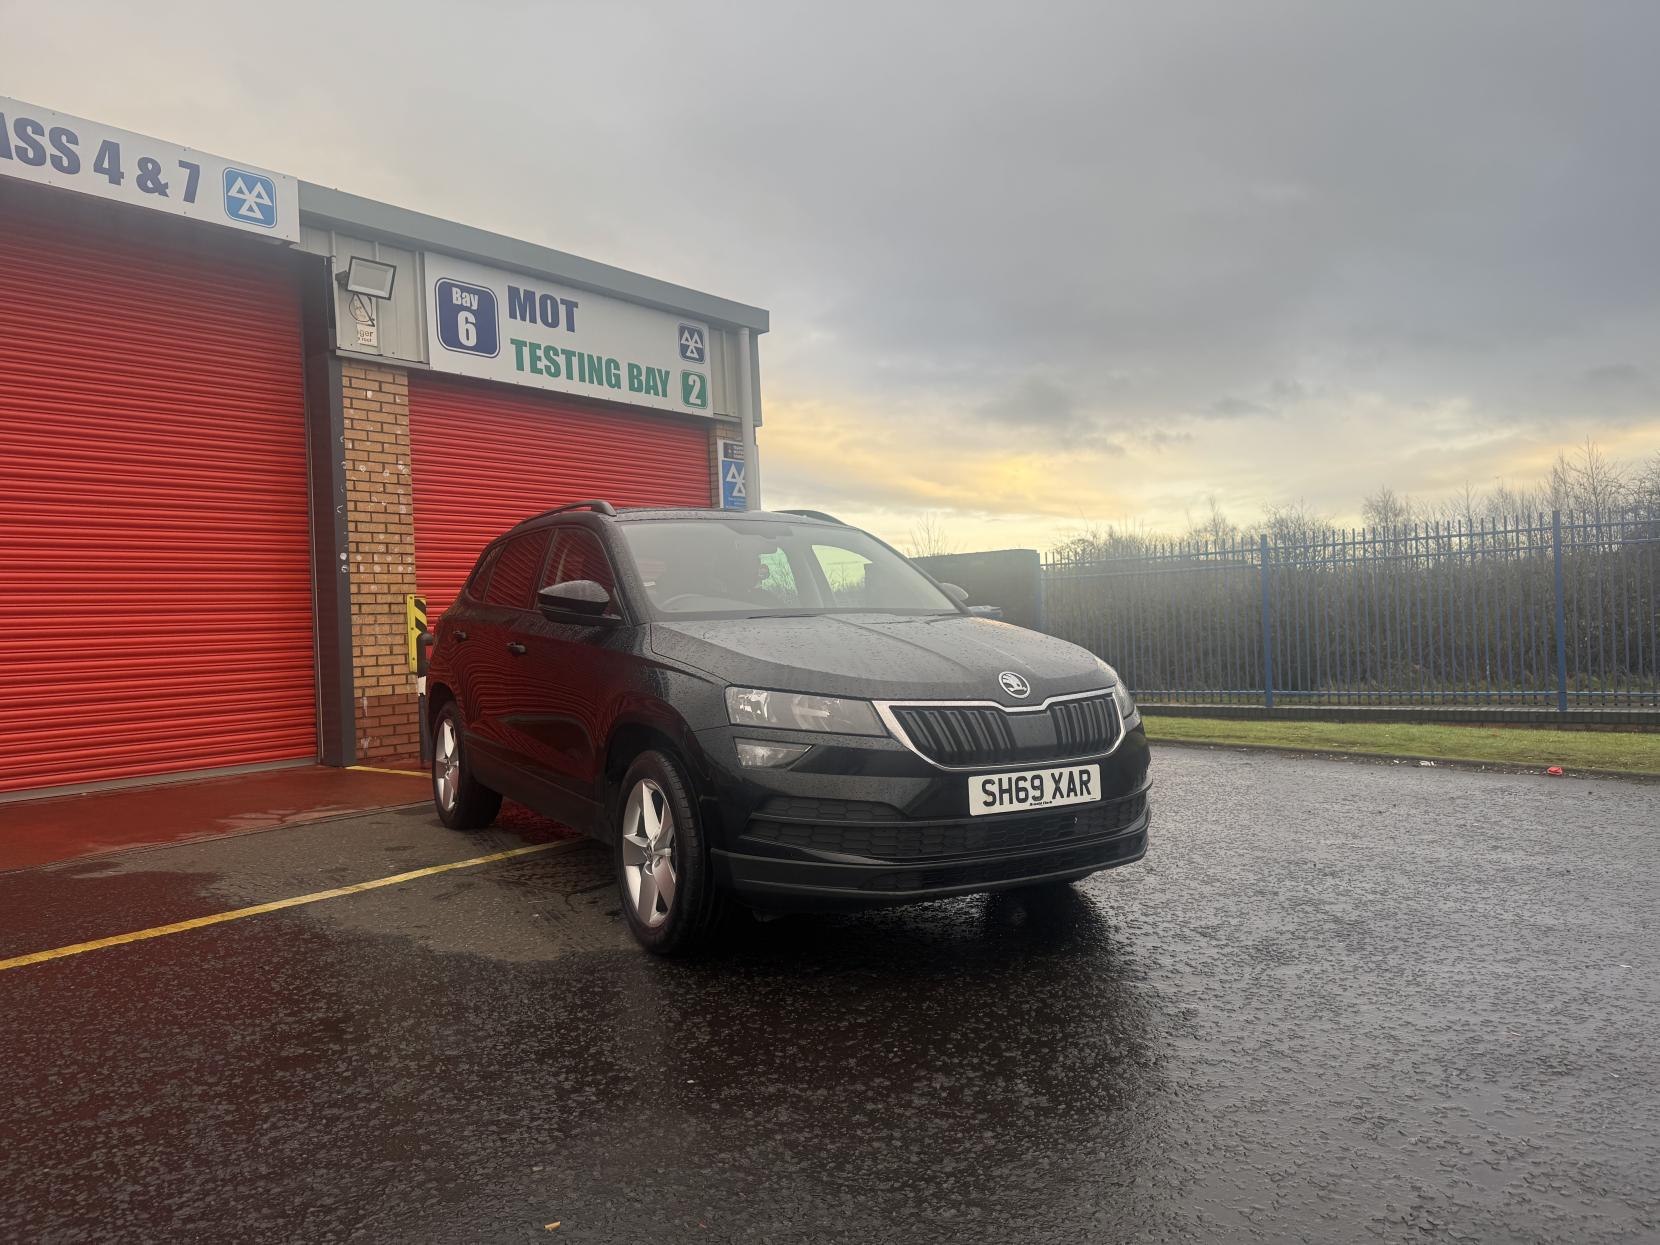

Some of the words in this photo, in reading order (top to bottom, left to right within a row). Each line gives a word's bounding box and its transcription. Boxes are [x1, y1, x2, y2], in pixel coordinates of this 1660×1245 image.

[93, 139, 124, 186] 4
[136, 157, 169, 198] &
[178, 160, 200, 204] 7
[451, 287, 478, 311] Bay
[507, 285, 579, 333] MOT
[457, 311, 477, 347] 6
[510, 338, 621, 390] TESTING
[628, 362, 670, 398] BAY
[688, 374, 701, 406] 2
[981, 774, 1044, 807] SH69
[1051, 769, 1091, 800] XAR
